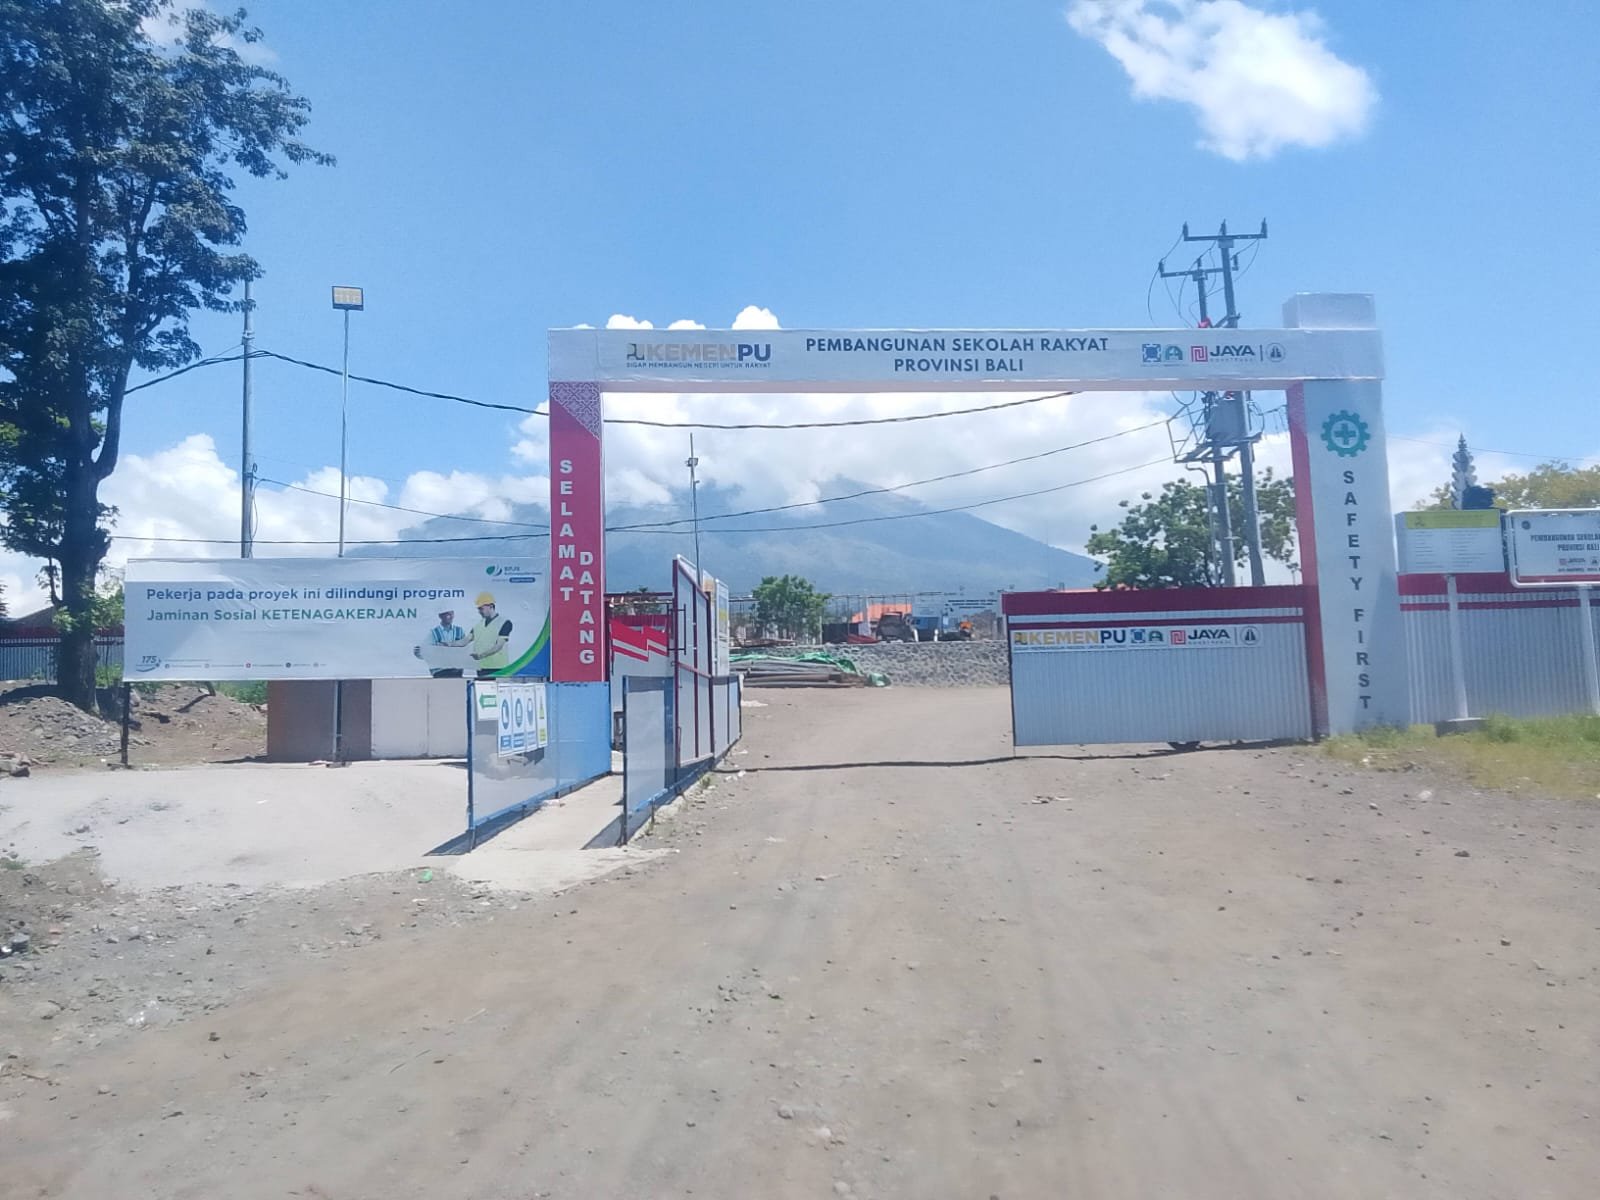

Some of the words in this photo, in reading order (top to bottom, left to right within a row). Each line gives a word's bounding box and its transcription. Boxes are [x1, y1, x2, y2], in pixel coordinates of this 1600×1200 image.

[806, 338, 945, 351] PEMBANGUNAN
[952, 338, 1034, 351] SEKOLAH
[1040, 338, 1108, 351] RAKYAT
[1210, 345, 1255, 357] JAYA
[645, 343, 771, 361] KEMENPU
[894, 358, 979, 372] PROVINSI
[985, 358, 1024, 371] BALI
[558, 459, 576, 602] SELAMAT
[146, 588, 202, 601] Pekerja
[207, 588, 244, 601] pada
[249, 588, 299, 601] proyek
[303, 587, 321, 599] ini
[325, 587, 398, 600] dilindungi
[403, 588, 465, 600] program
[1342, 470, 1363, 592] SAFETY
[1353, 608, 1373, 710] FIRST
[146, 609, 209, 621] Jaminan
[214, 609, 257, 620] Sosial
[262, 608, 418, 620] KETENAGAKERJAAN
[579, 551, 595, 665] DATANG
[1029, 629, 1126, 645] KEMENPU
[1188, 629, 1231, 640] JAYA
